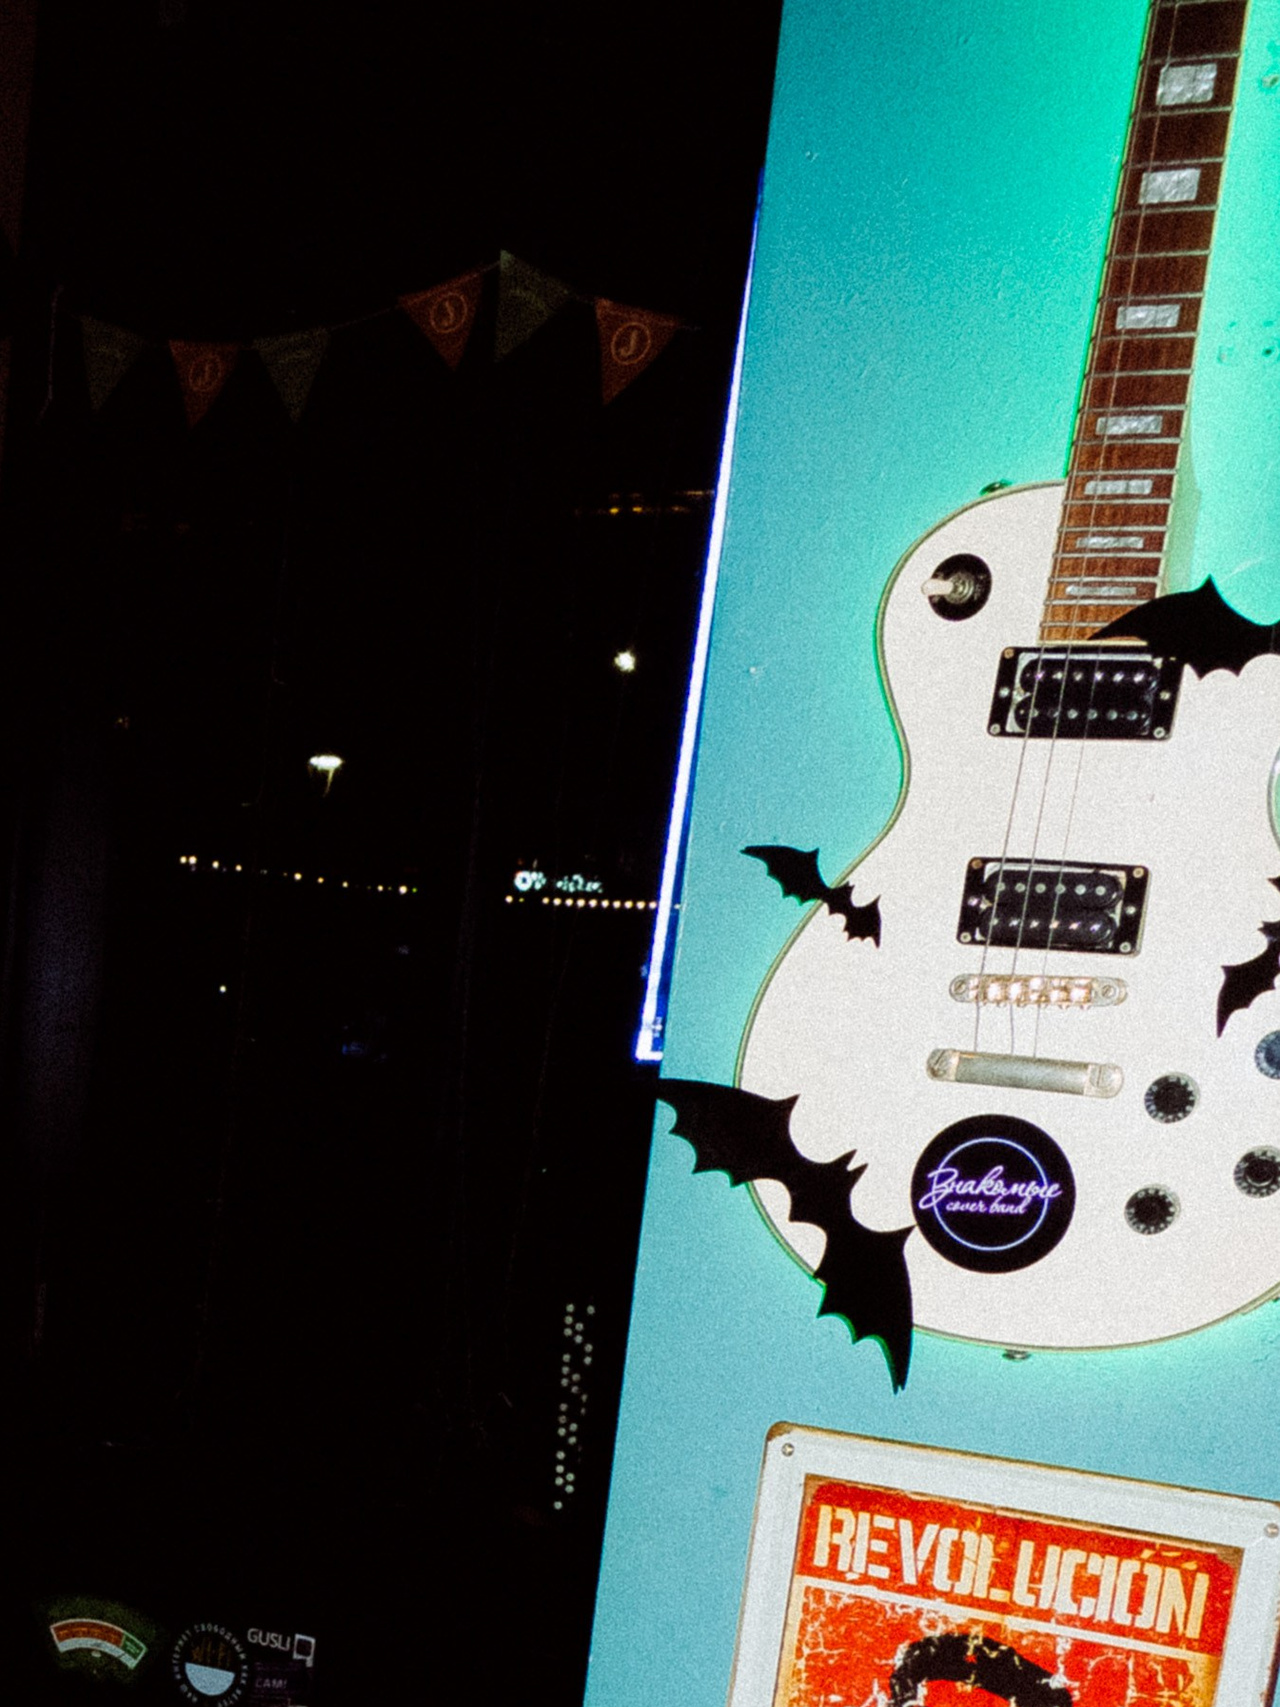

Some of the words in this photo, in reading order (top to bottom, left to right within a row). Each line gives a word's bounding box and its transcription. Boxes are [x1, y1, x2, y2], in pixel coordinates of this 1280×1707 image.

[945, 1199, 988, 1213] cover
[988, 1195, 1033, 1214] band
[246, 1627, 291, 1652] GUSLI
